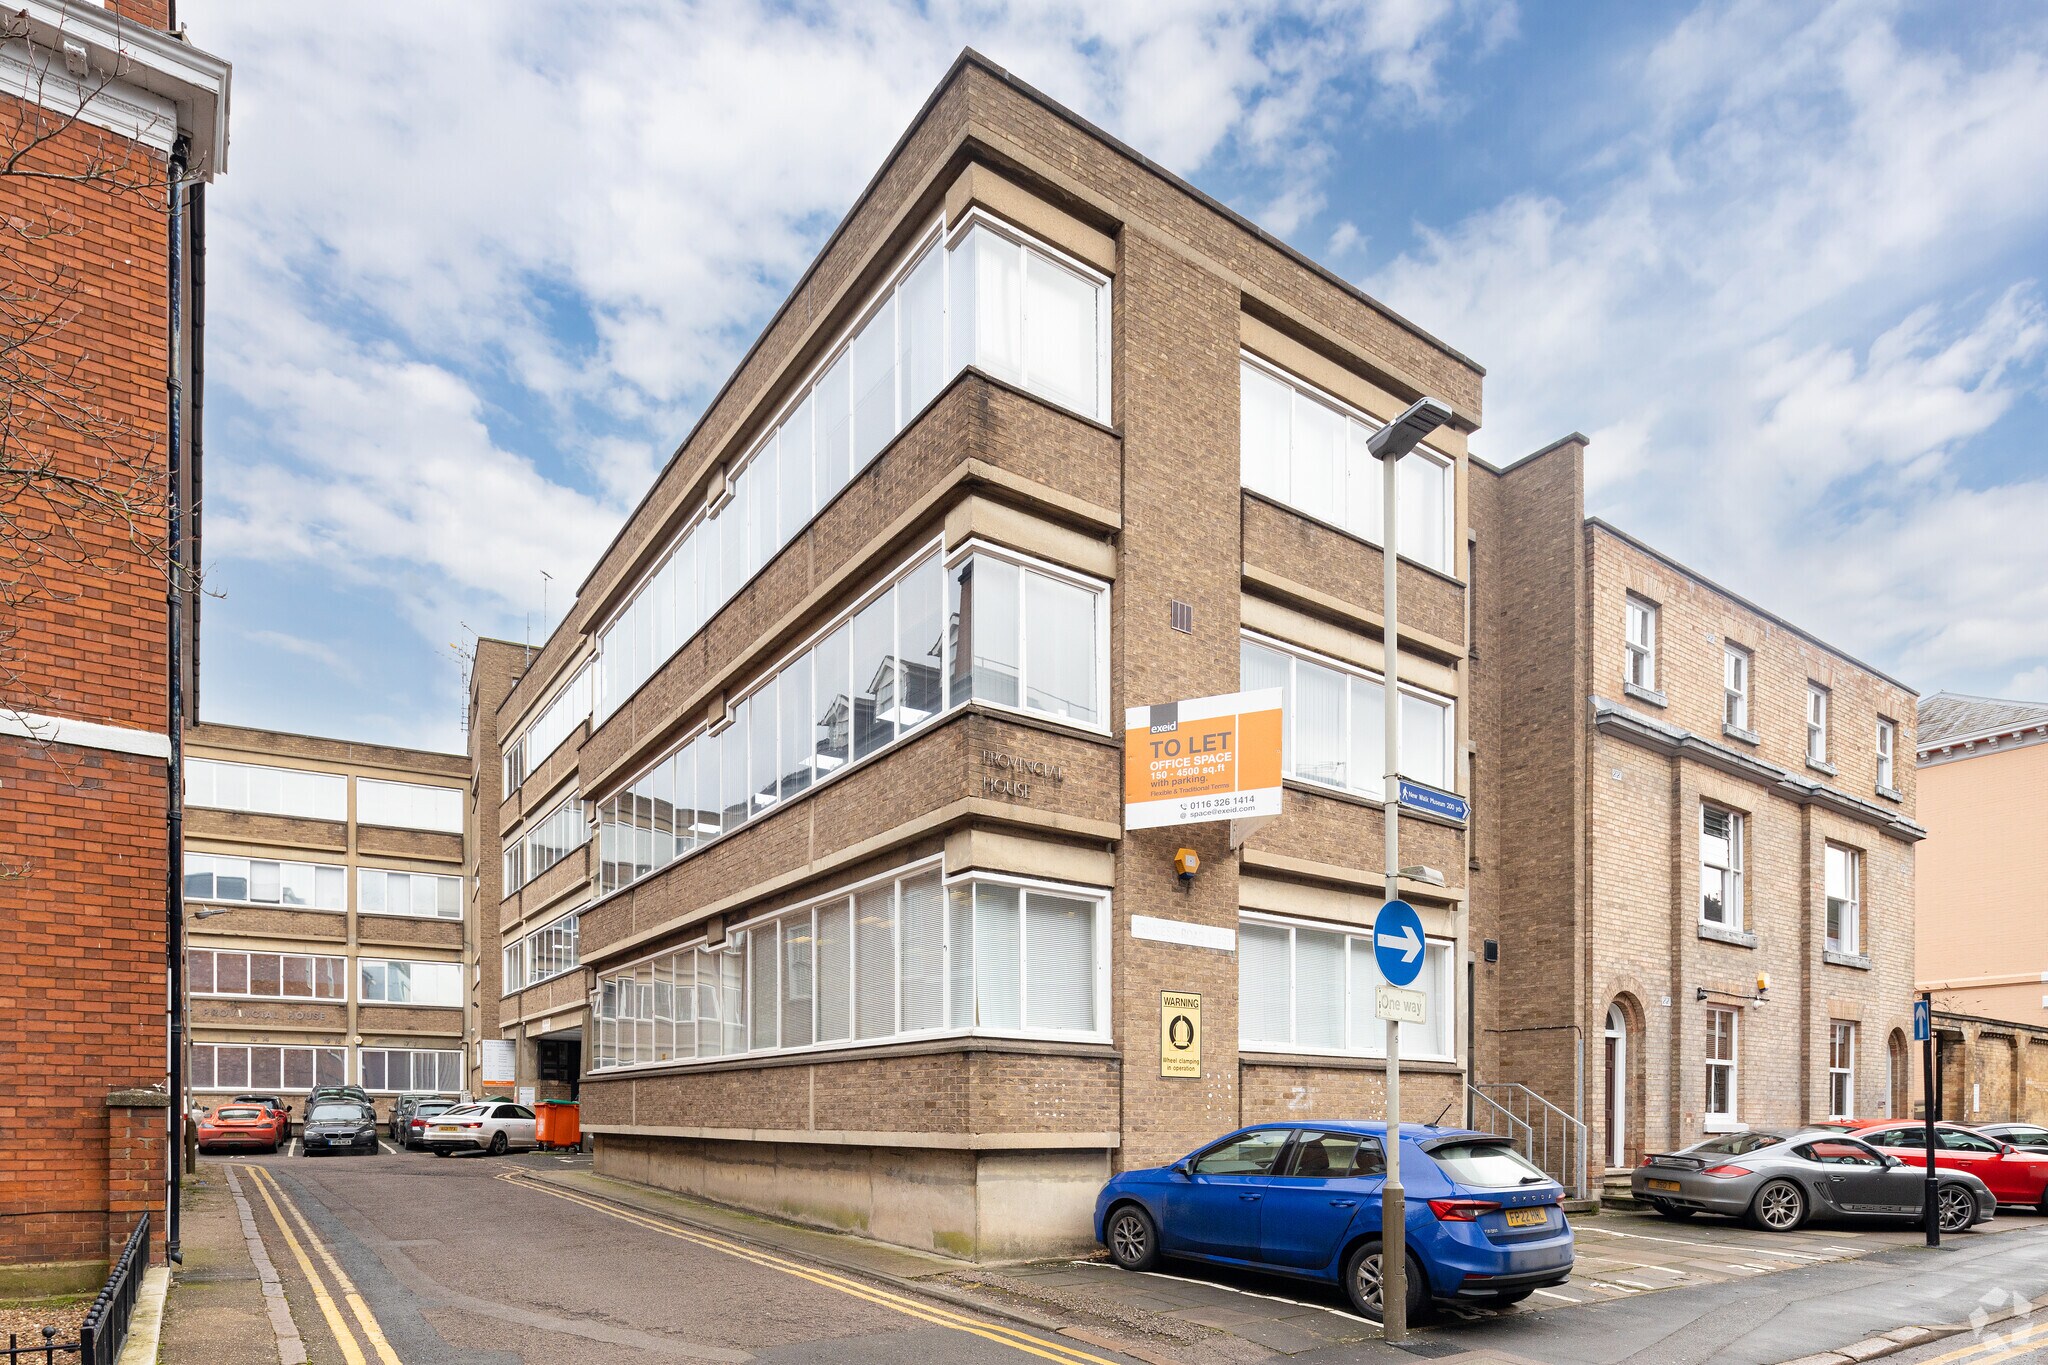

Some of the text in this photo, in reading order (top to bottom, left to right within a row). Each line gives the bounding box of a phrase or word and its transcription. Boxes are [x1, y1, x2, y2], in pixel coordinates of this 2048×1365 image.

[1151, 721, 1176, 733] exeid
[1150, 731, 1232, 759] TO LET
[982, 750, 1063, 782] PROVINCIAL
[1150, 751, 1232, 771] OFFICE SPACE
[1150, 770, 1168, 780] 150
[1176, 766, 1199, 777] 4500
[1202, 763, 1225, 776] sq.ft
[983, 776, 1031, 799] HOUSE
[1150, 775, 1208, 790] with parking.
[1150, 788, 1172, 797] Flexible
[1179, 784, 1210, 794] Traditional
[1211, 782, 1230, 790] Terms
[1190, 795, 1255, 810] 0116 326 1414
[1408, 791, 1418, 799] New
[1419, 794, 1429, 802] Walk
[1430, 797, 1446, 807] Museum
[1189, 804, 1256, 819] space@exeid.com
[1163, 996, 1199, 1009] WARNING
[1381, 993, 1422, 1017] One way
[202, 1008, 326, 1020] PROVINCIAL HOUSE
[1179, 1058, 1199, 1066] clamping
